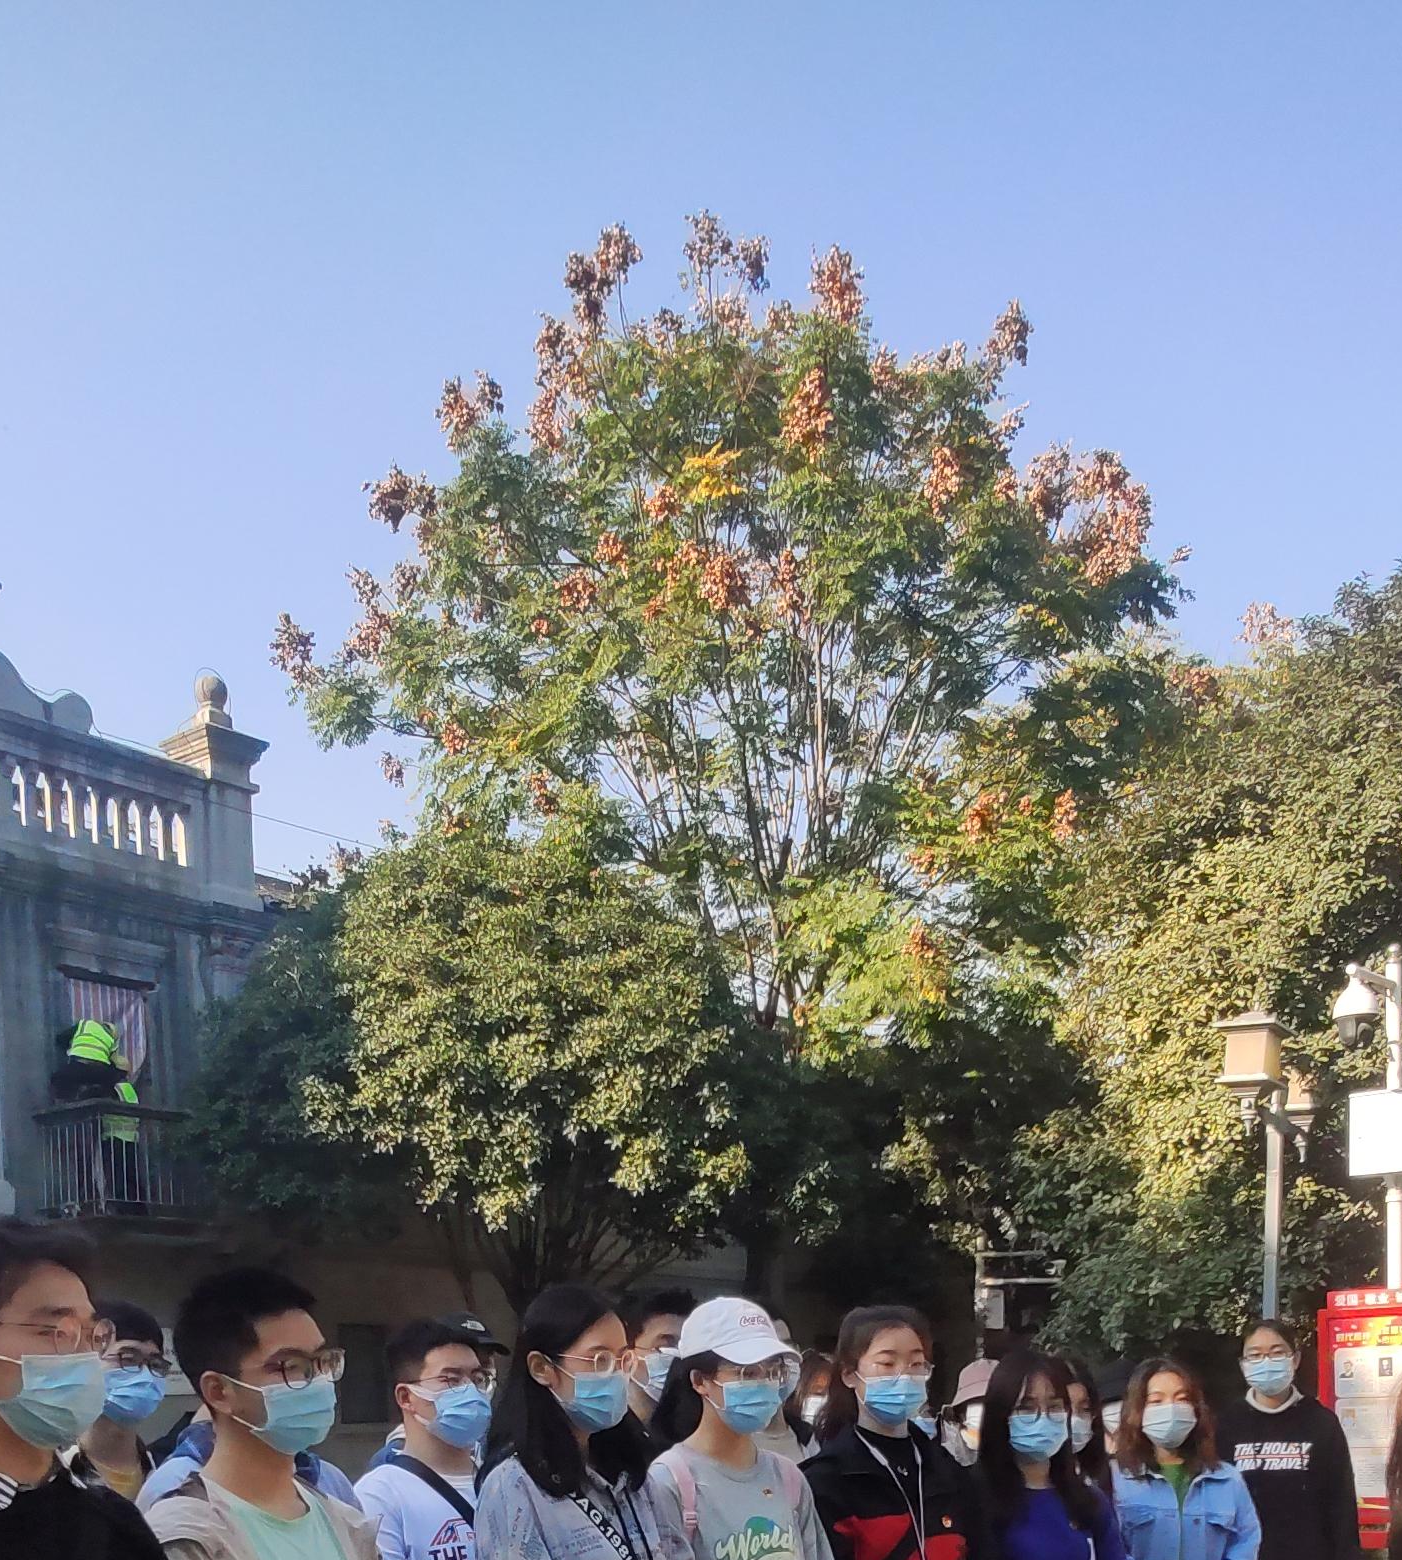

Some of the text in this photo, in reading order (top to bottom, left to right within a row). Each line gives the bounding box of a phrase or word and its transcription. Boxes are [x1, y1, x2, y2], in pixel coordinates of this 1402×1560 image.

[1334, 1294, 1358, 1306] 爱国
[1365, 1292, 1389, 1305] 敬业
[1234, 1443, 1261, 1457] THE
